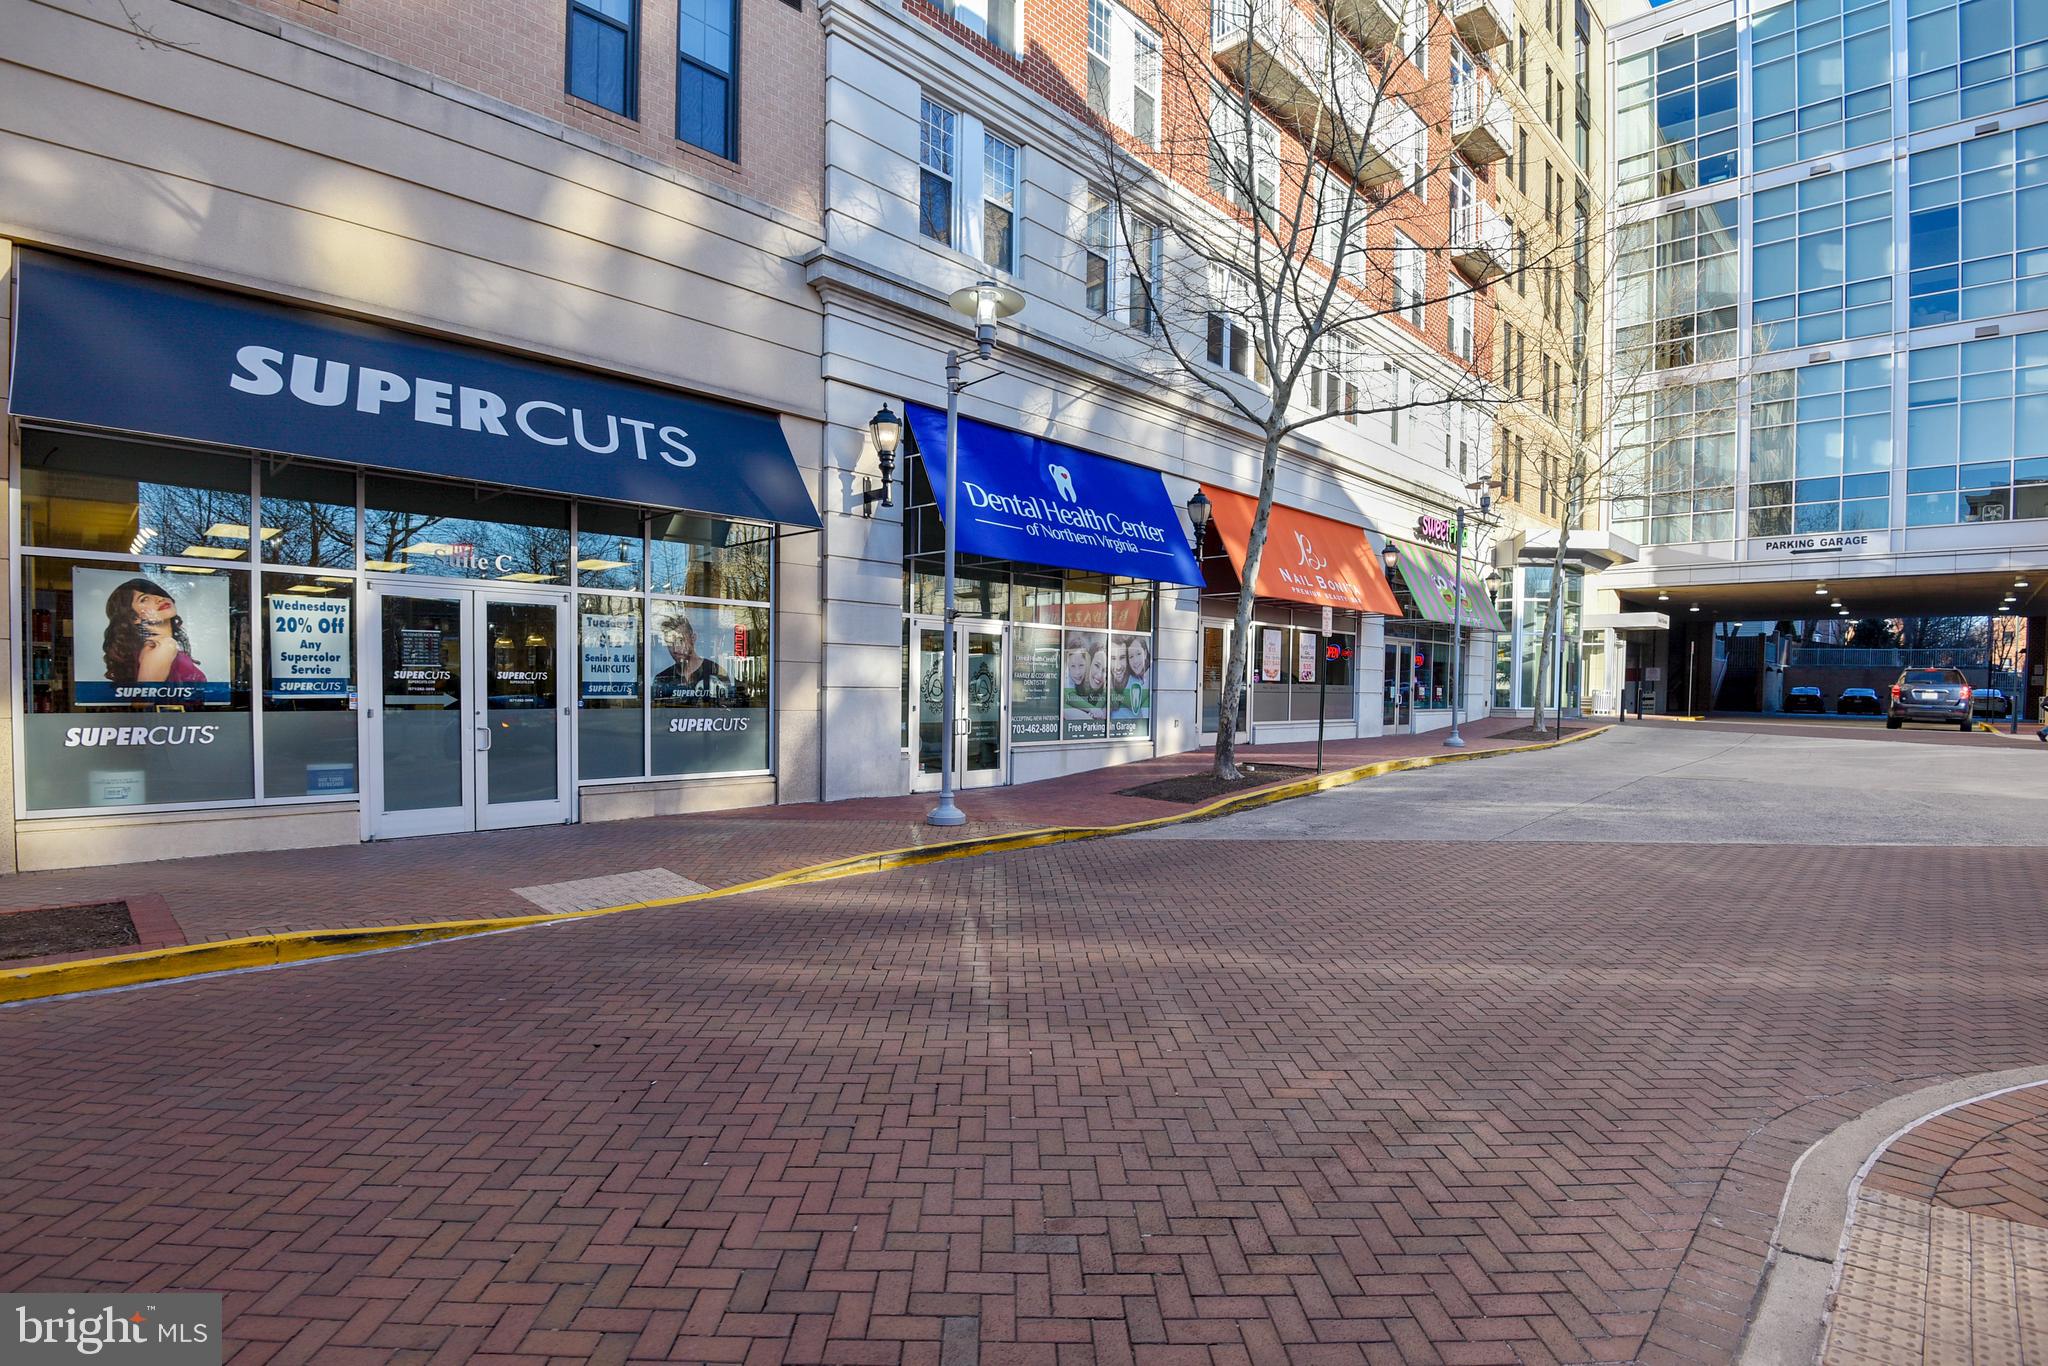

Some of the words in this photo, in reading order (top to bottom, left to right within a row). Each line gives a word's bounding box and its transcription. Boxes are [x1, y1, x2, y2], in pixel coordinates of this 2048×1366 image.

[229, 345, 697, 468] SUPERCUTS
[962, 481, 1042, 520] Dental
[1040, 498, 1107, 532] Health
[1106, 513, 1165, 543] Center
[1422, 514, 1468, 548] sweetFrg
[1026, 523, 1041, 537] of
[1041, 525, 1097, 546] Northern
[1096, 534, 1139, 554] Virginia
[1765, 539, 1815, 550] PARKING
[1820, 536, 1868, 547] GARAGE
[434, 548, 489, 571] Suite
[495, 554, 512, 572] C
[1279, 567, 1314, 587] NAIL
[272, 600, 346, 614] Wednesdays
[275, 617, 313, 633] 20%
[318, 618, 345, 634] Off
[300, 640, 322, 651] Any
[280, 652, 341, 664] Supercolor
[584, 653, 612, 663] Senior
[613, 654, 620, 663] &
[622, 654, 636, 663] Kid
[291, 665, 332, 675] Service
[393, 670, 451, 680] SUPERCUTS
[590, 664, 631, 673] HAIRCUTS
[496, 671, 549, 680] SUPERCUTS
[115, 687, 194, 698] SUPERCUTS
[279, 682, 342, 691] SUPERCUTS
[669, 718, 749, 732] SUPERCUTS
[1012, 723, 1058, 734] 703-462-8800
[1068, 723, 1082, 732] Free
[1082, 722, 1106, 733] Parking
[1116, 722, 1137, 732] Garage
[65, 725, 219, 747] SUPERCUTS
